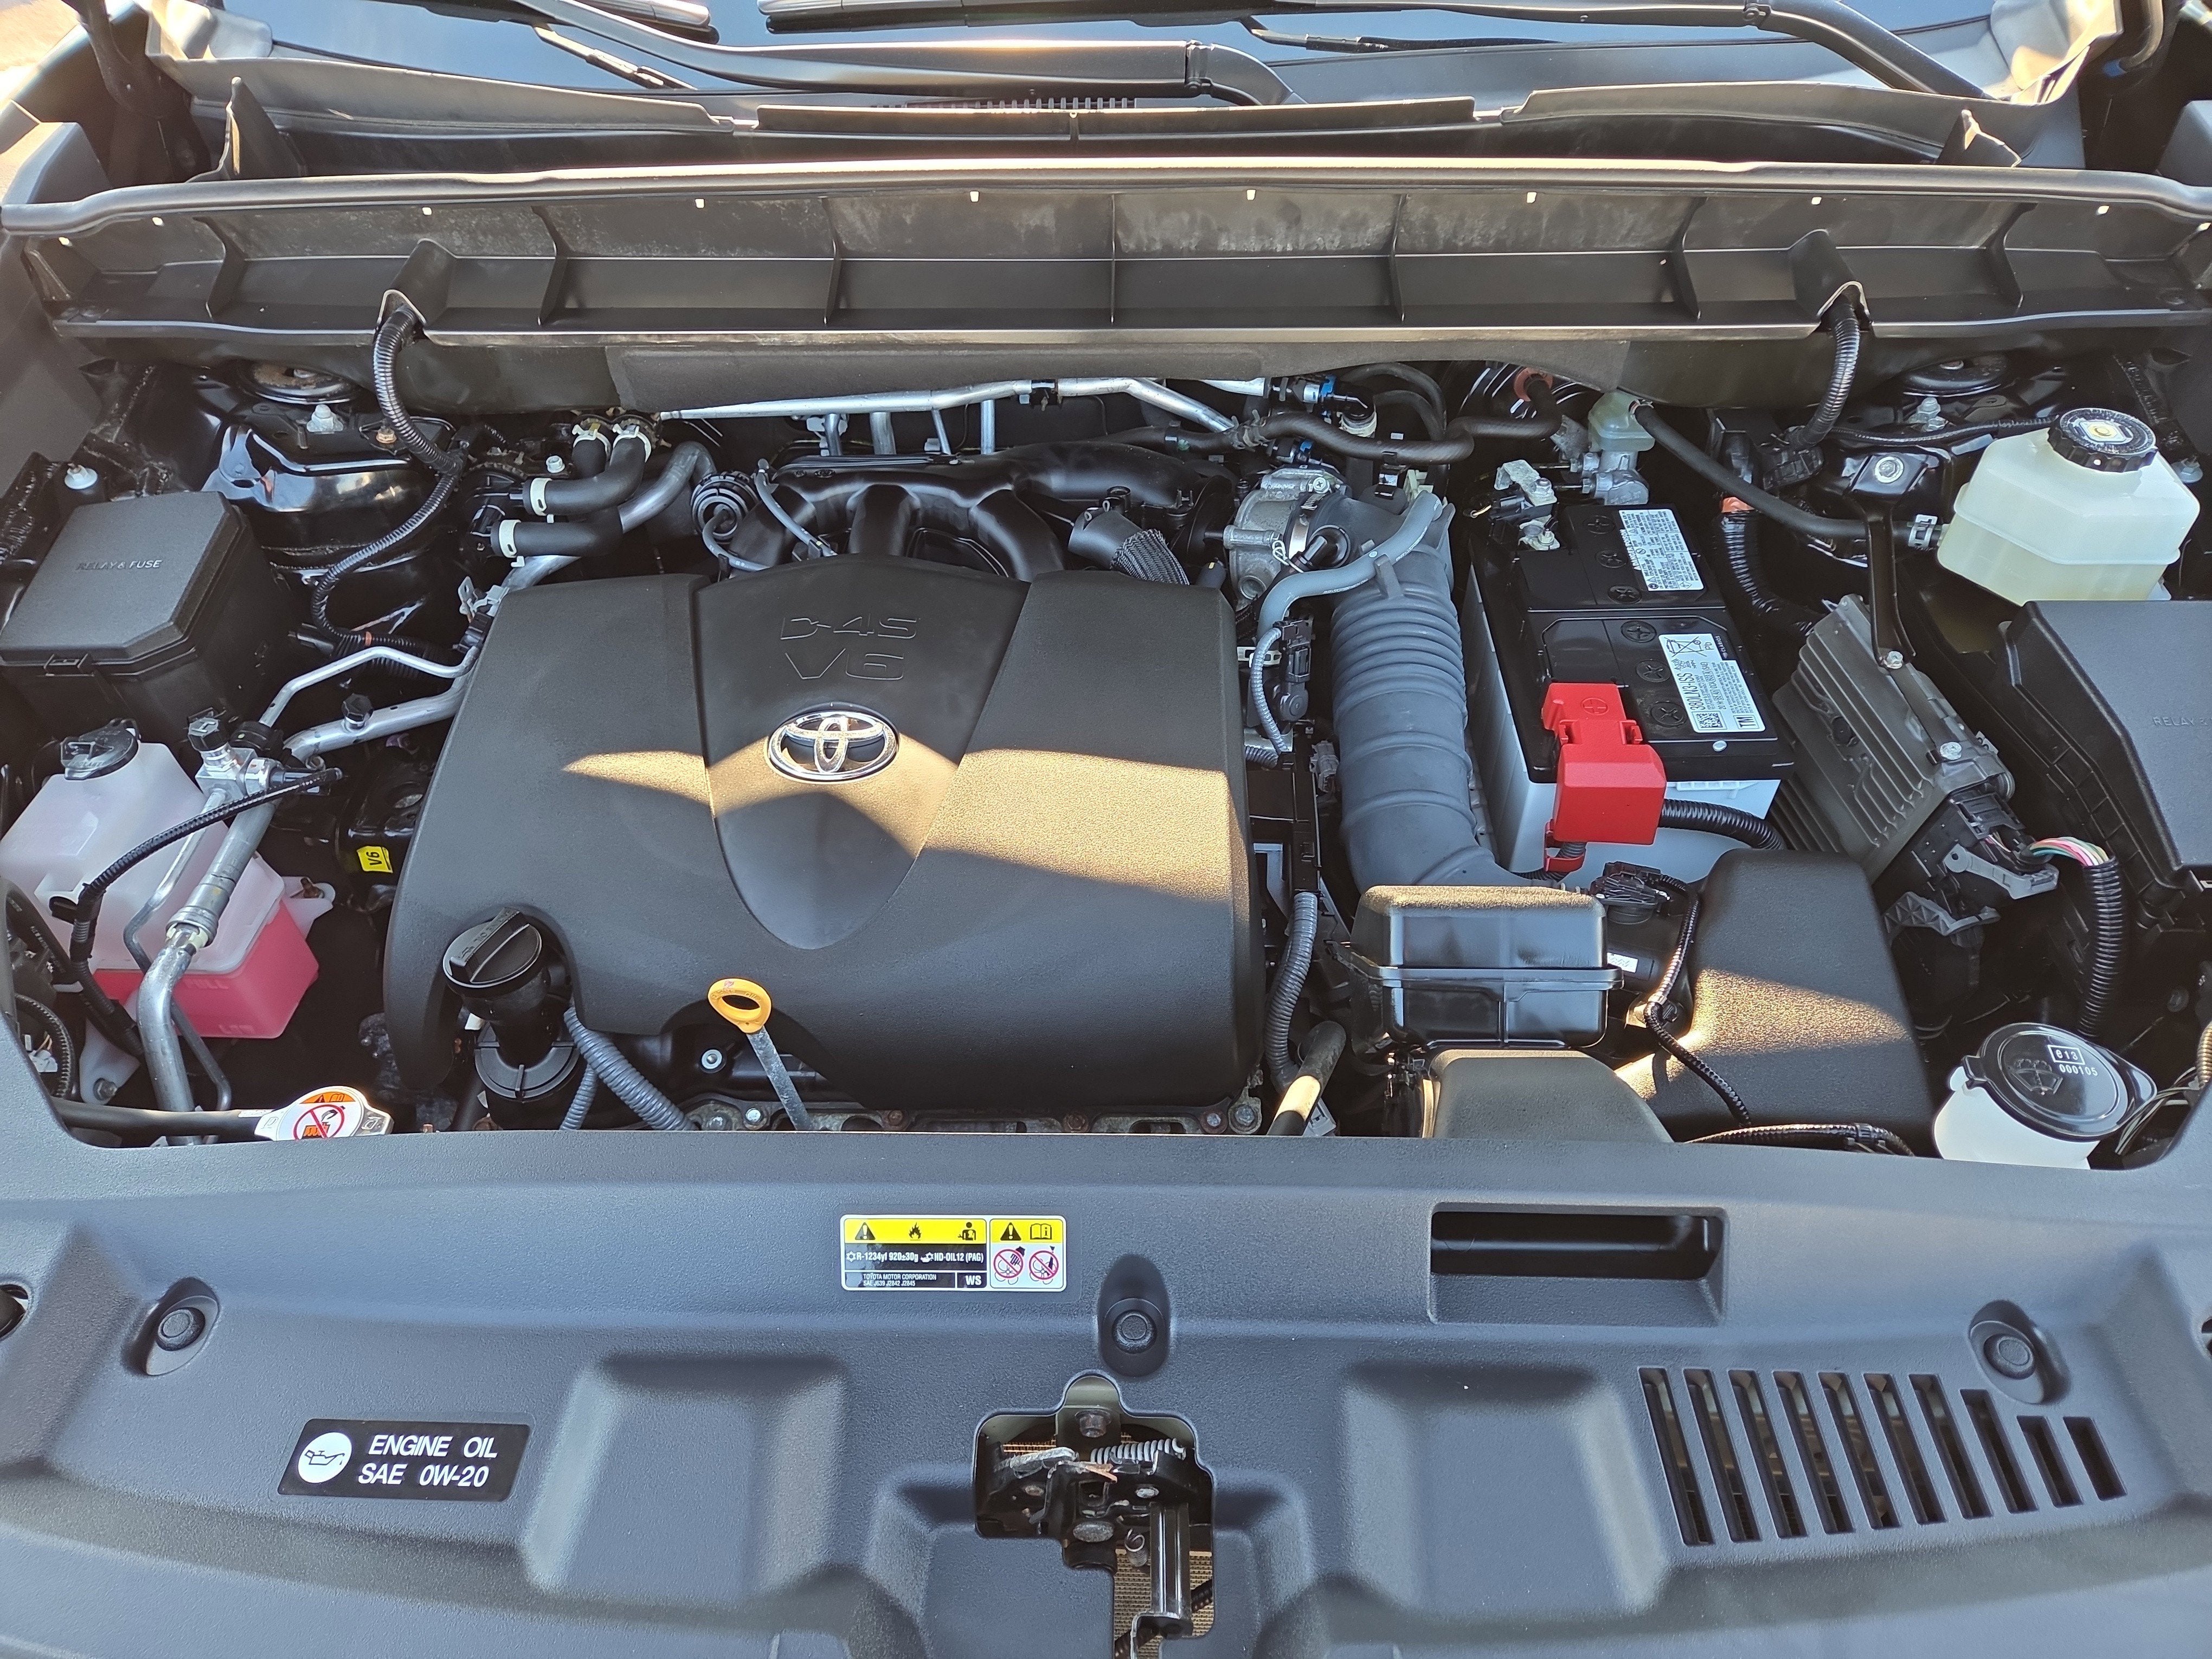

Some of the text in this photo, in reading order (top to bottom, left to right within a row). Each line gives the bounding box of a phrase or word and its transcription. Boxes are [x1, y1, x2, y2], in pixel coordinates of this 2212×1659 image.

[129, 560, 163, 569] FUSE
[1703, 641, 1714, 650] Pb
[785, 647, 904, 680] V6
[1676, 672, 1706, 710] 380LN3-ISS
[1736, 716, 1756, 728] TM
[2152, 716, 2195, 726] RELAY
[365, 851, 382, 865] V6
[2056, 1049, 2078, 1060] e13
[2059, 1064, 2098, 1076] 000105
[966, 1252, 984, 1263] (PAG)
[966, 1275, 982, 1285] WS
[369, 1434, 498, 1458] ENGINE OIL
[358, 1464, 490, 1487] SAE 0W-20
